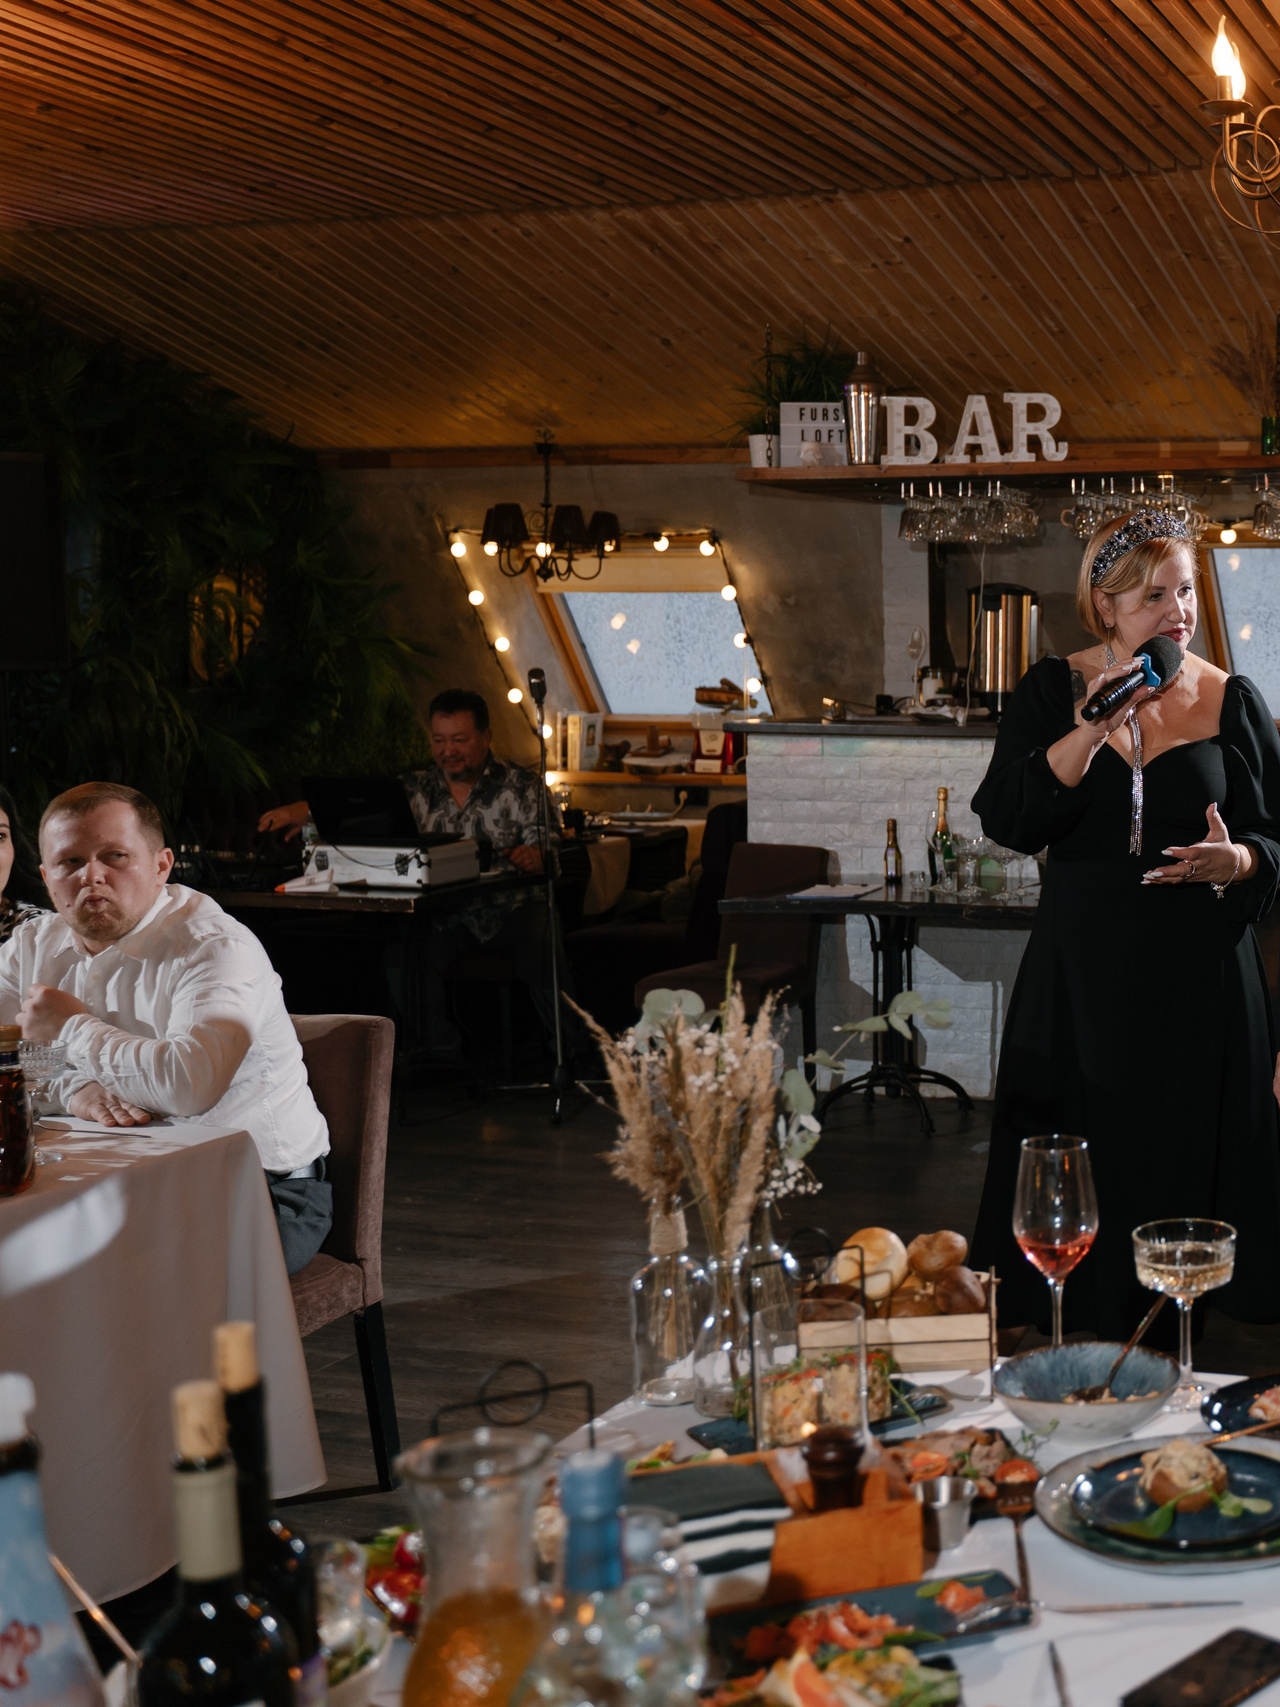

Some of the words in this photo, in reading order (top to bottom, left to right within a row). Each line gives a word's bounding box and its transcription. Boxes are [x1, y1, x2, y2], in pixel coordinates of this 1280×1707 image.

[799, 407, 840, 422] FURS
[801, 429, 845, 443] LOFT
[880, 392, 1069, 466] BAR
